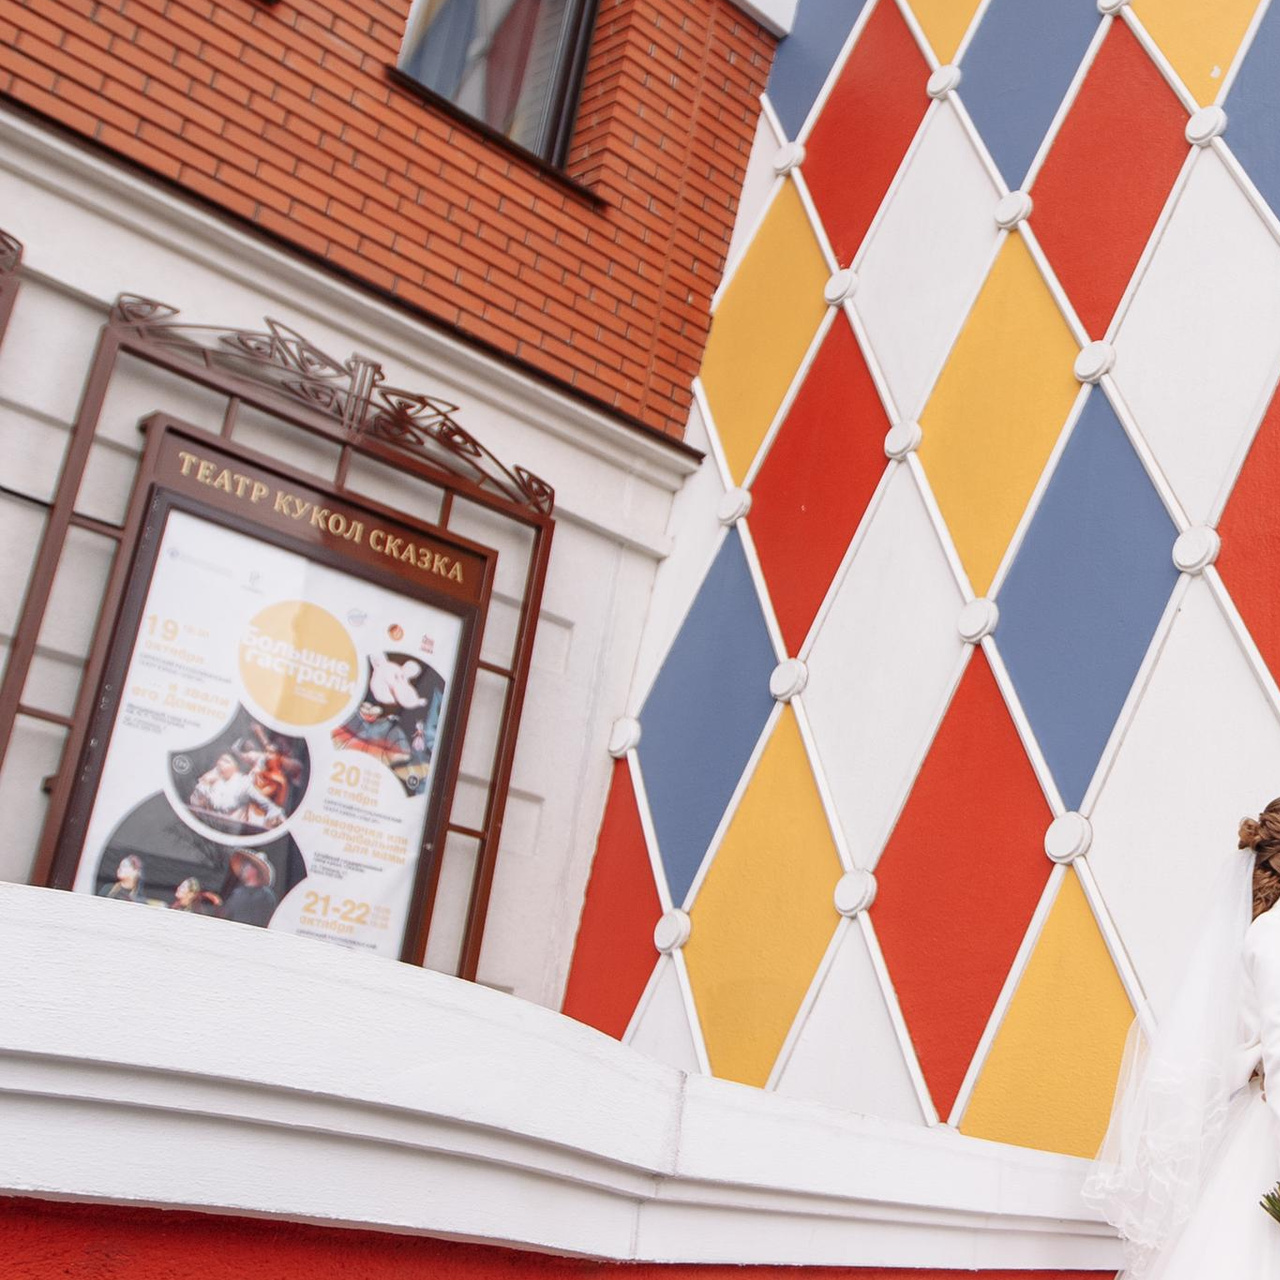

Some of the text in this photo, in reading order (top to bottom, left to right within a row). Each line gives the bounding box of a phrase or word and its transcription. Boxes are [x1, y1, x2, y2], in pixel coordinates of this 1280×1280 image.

[178, 451, 464, 583] ТЕАТР КУКОЛ СКАЗКА
[148, 613, 180, 641] 19
[242, 625, 350, 676] Большие
[245, 648, 356, 694] гастроли
[330, 761, 361, 787] 20
[301, 890, 371, 926] 21-22
